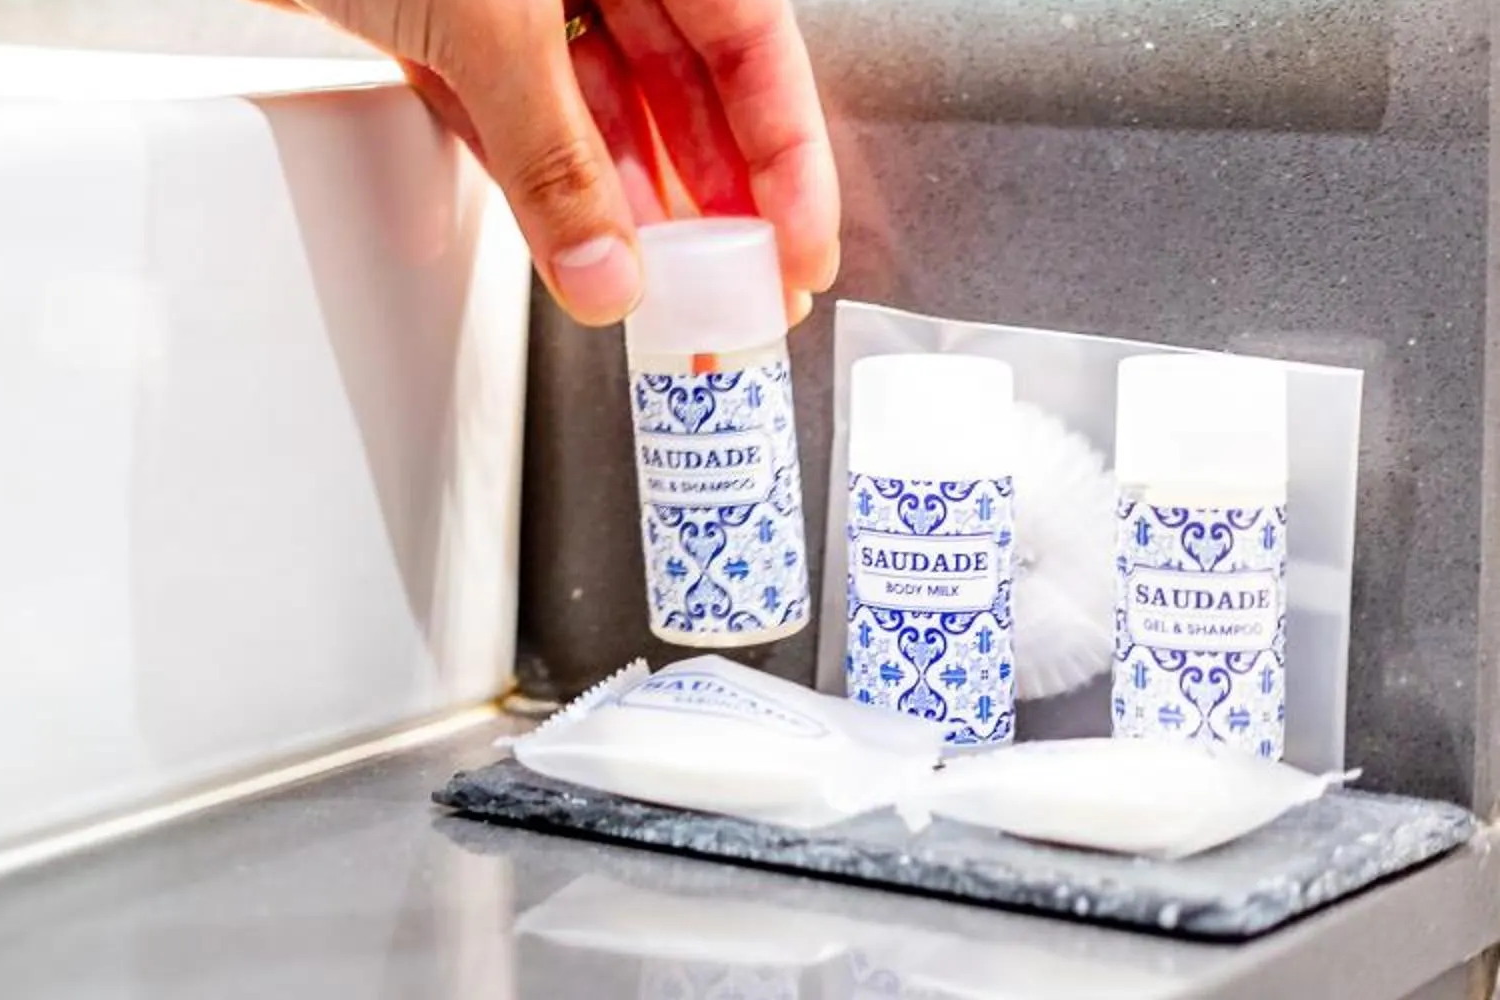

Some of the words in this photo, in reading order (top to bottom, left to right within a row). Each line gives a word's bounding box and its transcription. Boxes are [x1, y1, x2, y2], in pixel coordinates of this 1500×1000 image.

[641, 445, 761, 469] SAUDADE
[861, 546, 988, 573] SAUDADE
[886, 581, 922, 595] BODY
[927, 585, 960, 597] MILK
[1135, 583, 1270, 610] SAUDADE
[1143, 618, 1168, 633] GEL
[1173, 623, 1183, 635] &
[1187, 622, 1263, 637] SHAMPOO
